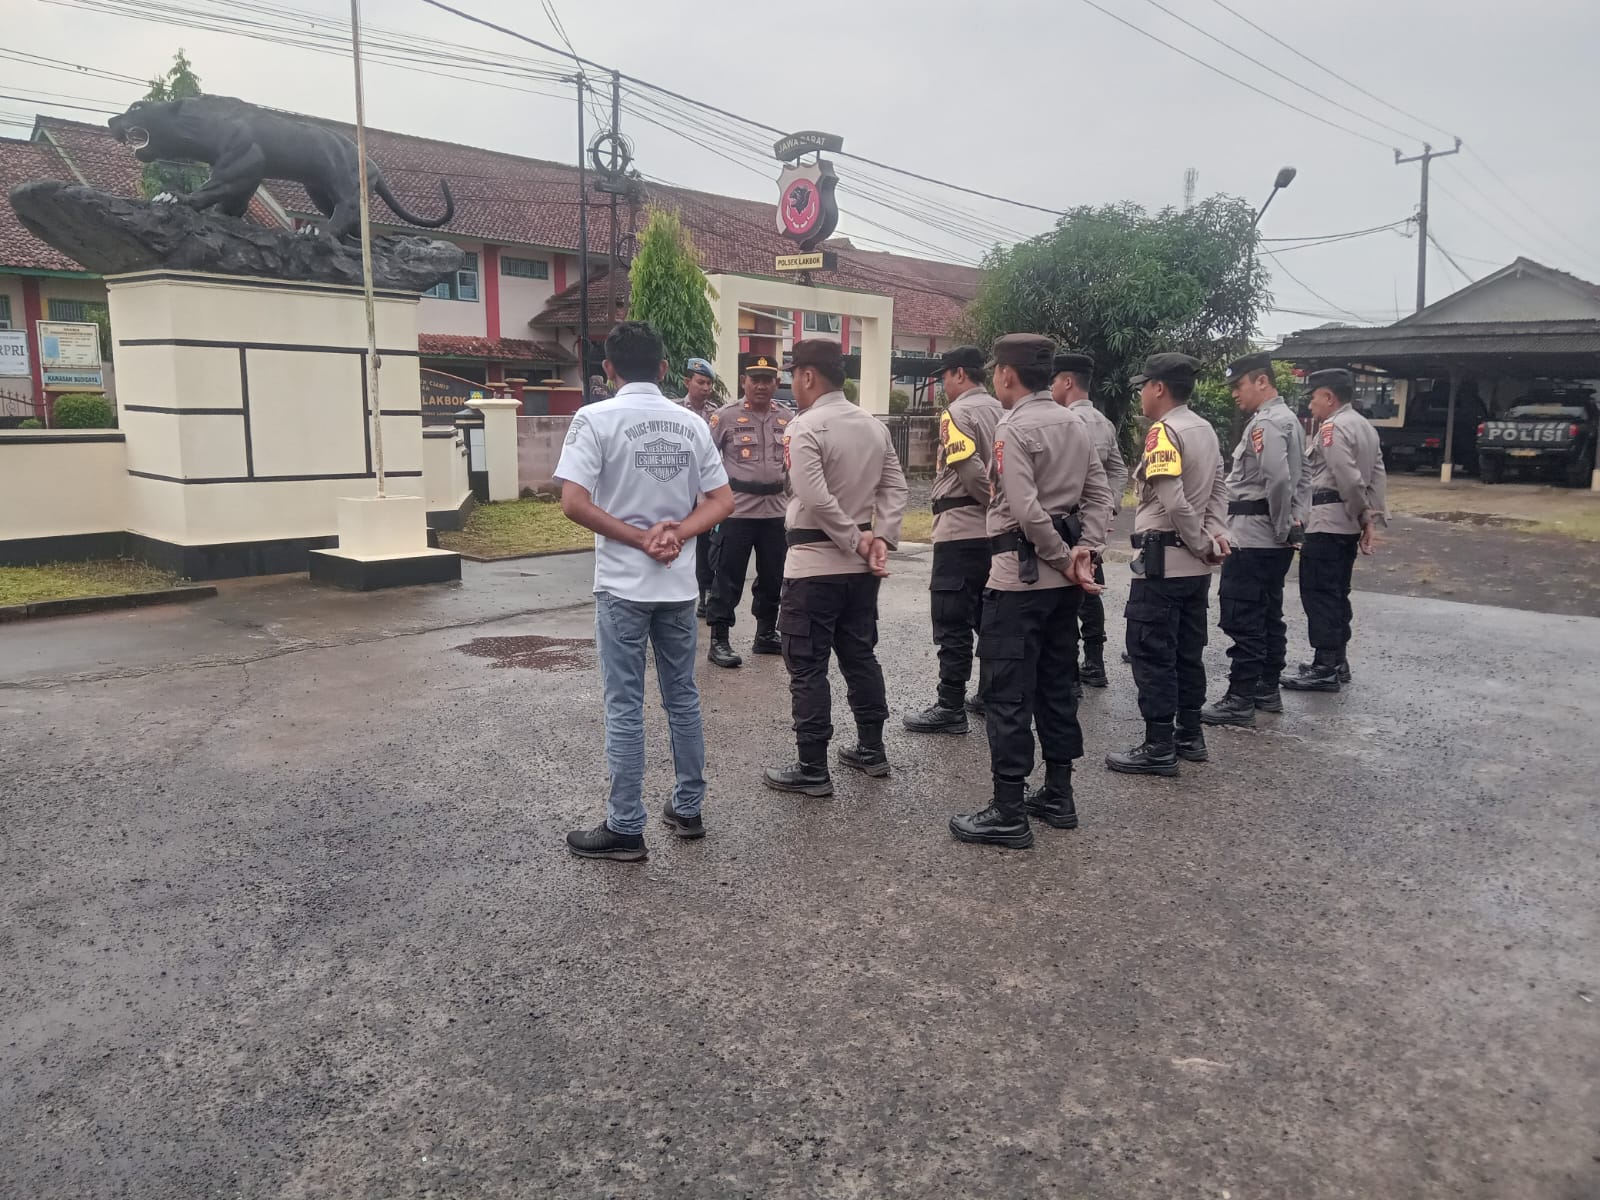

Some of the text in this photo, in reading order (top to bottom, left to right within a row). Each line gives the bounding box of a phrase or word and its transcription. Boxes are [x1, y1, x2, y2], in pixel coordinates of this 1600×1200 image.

[778, 138, 799, 153] JAWA
[778, 256, 820, 267] POLSEK LAKBOK
[422, 396, 466, 406] LAKBOK
[1488, 429, 1563, 441] POLISI
